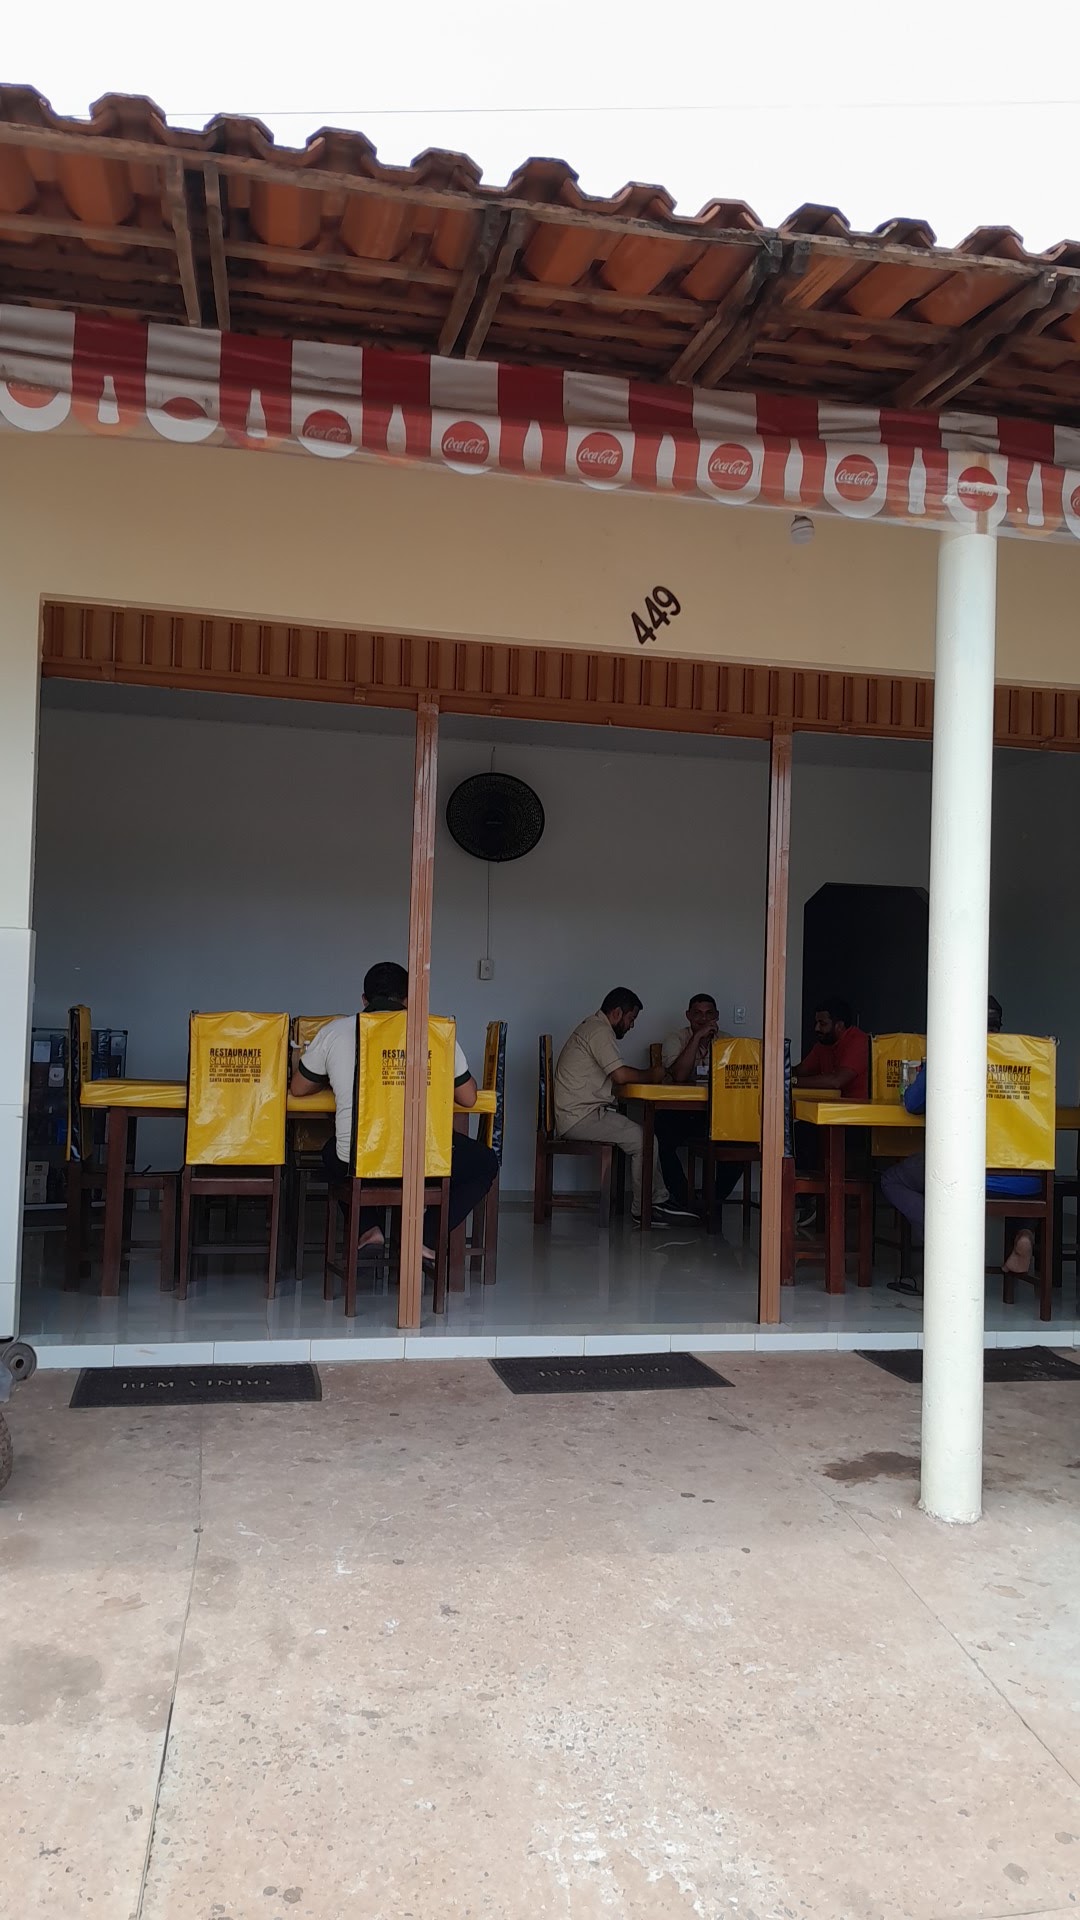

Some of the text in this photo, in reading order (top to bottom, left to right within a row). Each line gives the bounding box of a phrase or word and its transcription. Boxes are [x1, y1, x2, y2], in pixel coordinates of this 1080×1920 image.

[443, 437, 487, 454] Coca-Cola
[578, 448, 620, 465] Coca-Cola
[709, 458, 750, 475] Coca-Cola
[836, 469, 875, 486] Coca-Cola
[631, 585, 681, 645] 449
[209, 1048, 261, 1057] RESTAURANTE
[209, 1056, 261, 1065] SANTA LUZIA
[986, 1072, 1006, 1082] ANTA
[987, 1064, 1032, 1075] ESTAURANTE
